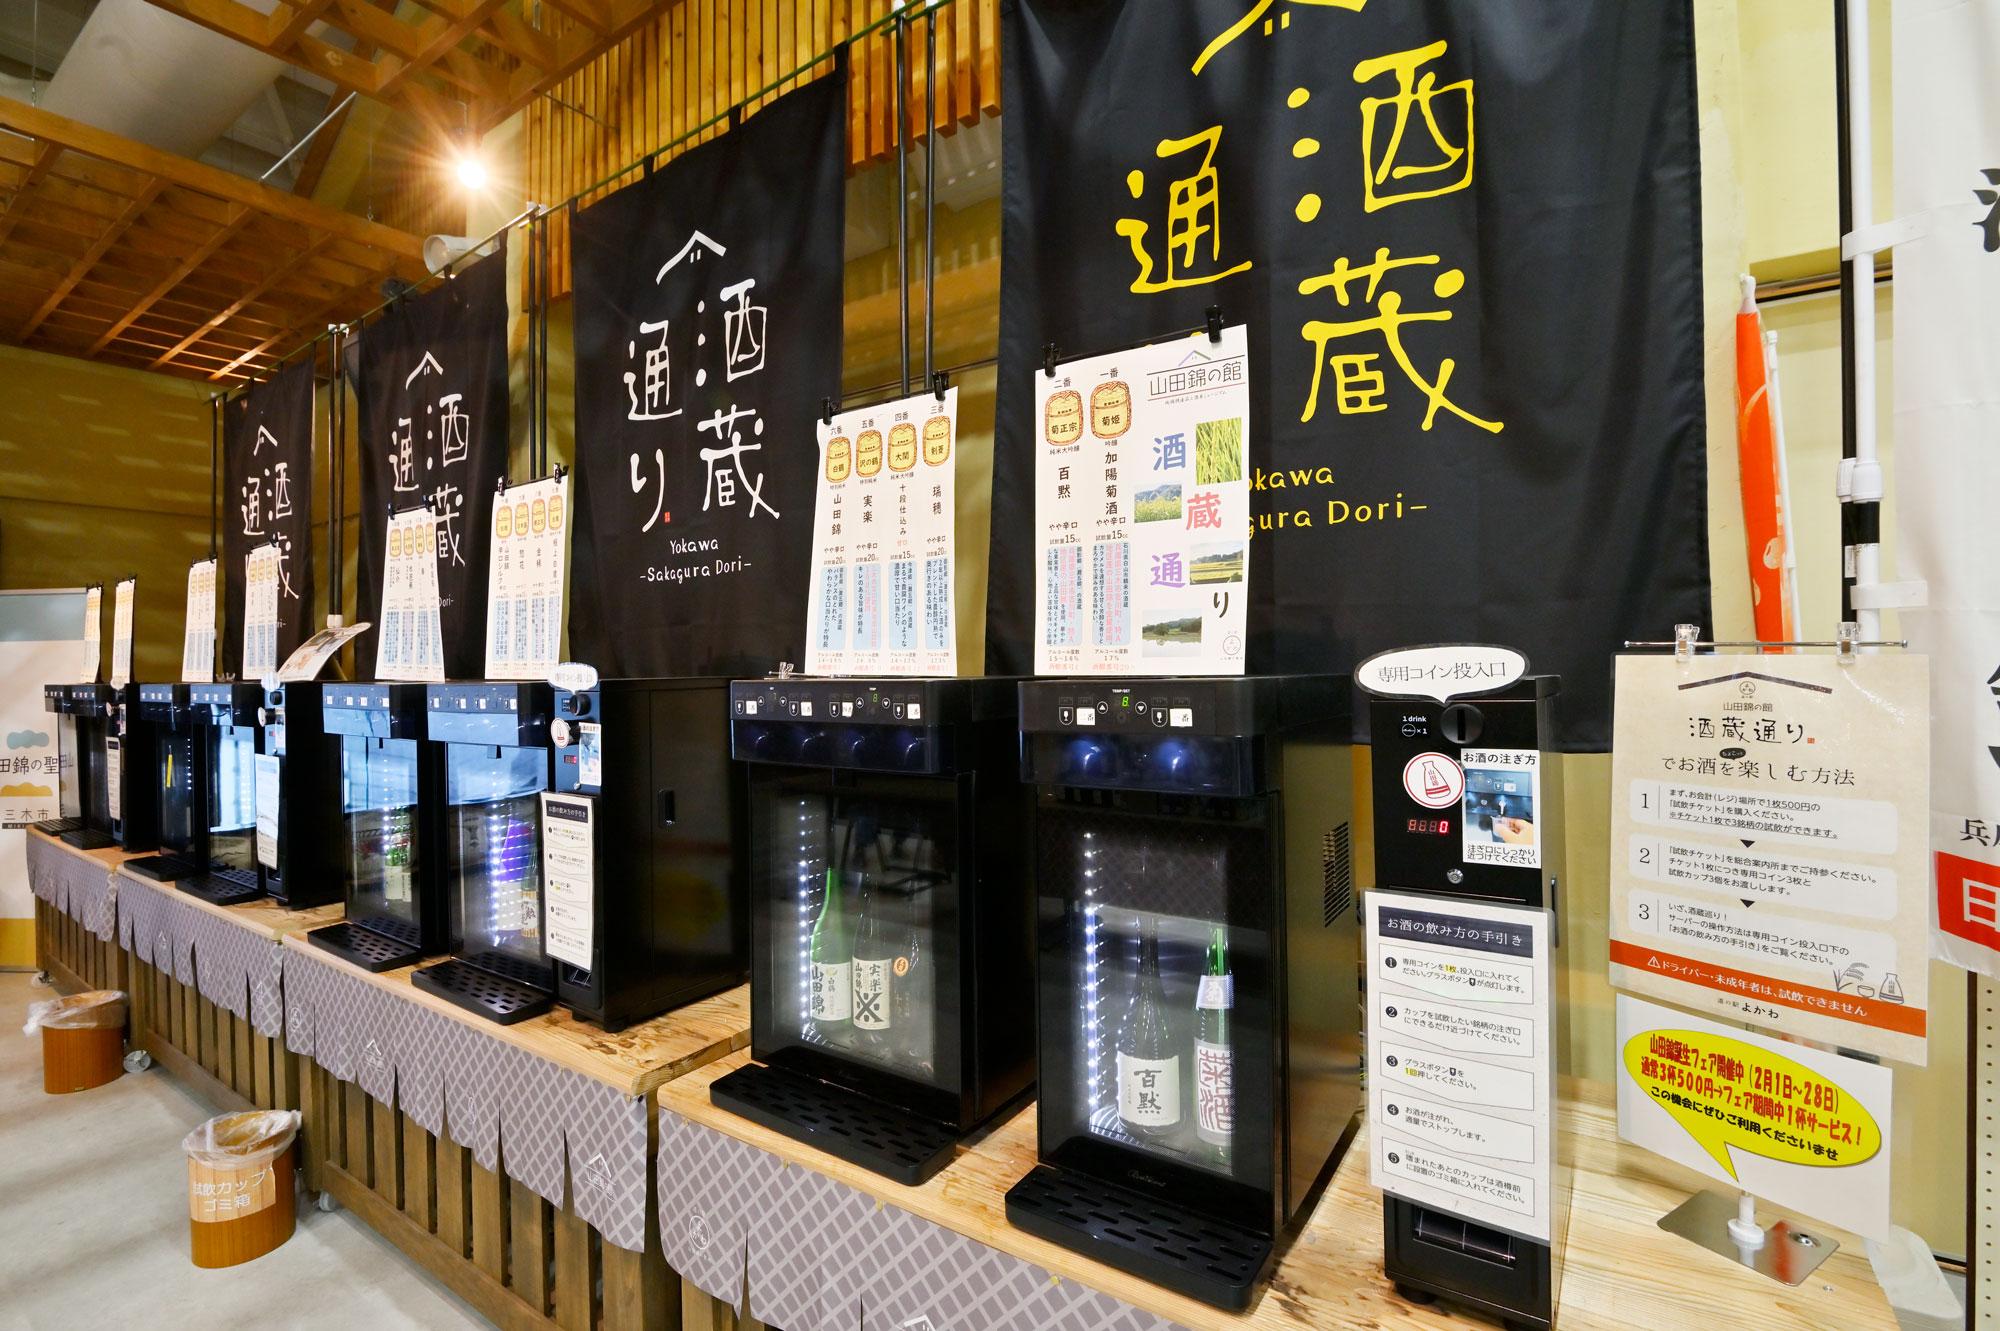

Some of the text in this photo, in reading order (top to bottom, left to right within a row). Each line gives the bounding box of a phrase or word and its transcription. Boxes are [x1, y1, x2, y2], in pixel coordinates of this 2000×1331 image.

[1115, 124, 1253, 294] 通
[1287, 40, 1504, 433] 酒蔵
[1054, 377, 1071, 389] 二番
[1100, 367, 1119, 378] 一番
[1150, 361, 1241, 396] 山田錦の館
[696, 279, 780, 520] 酒蔵
[624, 320, 682, 532] 通り
[1051, 422, 1078, 435] 菊正宗
[1102, 414, 1120, 427] 菊姫
[859, 457, 878, 468] 沢の鶴
[1153, 433, 1186, 471] 酒
[1058, 466, 1071, 499] 百黙
[1105, 452, 1118, 515] 加陽菊酒
[1249, 467, 1334, 491] kawa
[863, 495, 873, 523] 実楽
[932, 485, 941, 515] 瑞穂
[1186, 491, 1222, 531] 蔵
[1328, 493, 1427, 525] Dori-
[831, 494, 842, 536] 山田錦
[1049, 521, 1078, 530] やや辛口
[1096, 516, 1126, 526] やや辛口
[669, 538, 719, 555] Yokawa
[1150, 552, 1186, 588] 通
[1213, 591, 1229, 618] り
[1378, 661, 1506, 683] 専用コイン投入口
[1122, 696, 1129, 707] 8
[1723, 702, 1773, 713] 山田錦の館
[1689, 717, 1805, 745] 酒蔵通り
[1463, 752, 1537, 766] お酒の注ぎ方
[1661, 756, 1855, 787] でお酒を楽しむ方法
[4, 808, 50, 822] 三木市
[1640, 793, 1650, 809] 1
[1467, 845, 1535, 857] 注ぎ口にしっかり
[1467, 853, 1537, 865] 近づけてください
[1639, 847, 1651, 864] 2
[1668, 857, 1812, 888] チケット1枚につき専用コイン3枚と
[1639, 904, 1650, 920] 3
[1387, 918, 1523, 947] お酒の飲み方の手引き
[1668, 913, 1849, 956] サーバーの操作方法は専用コイン投入口下の
[811, 965, 825, 1015] 山田錦
[869, 963, 881, 992] 実楽
[1661, 960, 1867, 1018] ドライバー・未成年者は、試飲できません
[1741, 1002, 1779, 1019] よかわ
[1650, 1086, 1839, 1161] この機会にぜひご利用くださいませ
[204, 1193, 251, 1213] ゴミ箱
